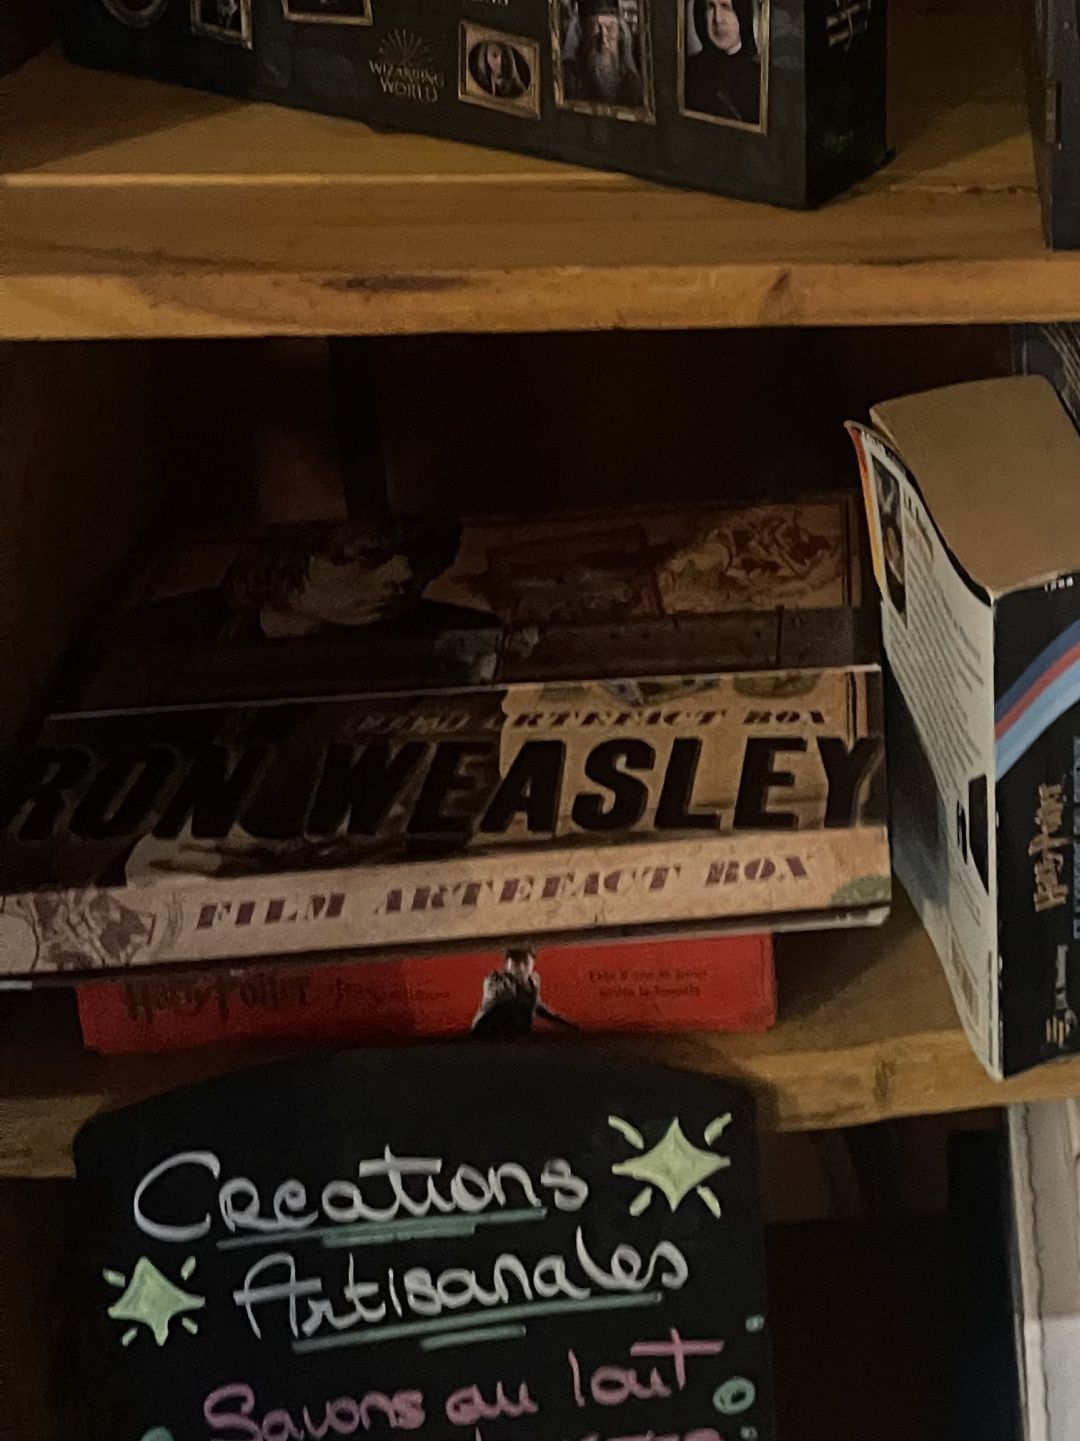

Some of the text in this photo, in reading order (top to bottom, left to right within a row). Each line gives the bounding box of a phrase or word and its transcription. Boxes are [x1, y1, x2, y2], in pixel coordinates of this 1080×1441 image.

[305, 735, 882, 840] WEASLEY
[196, 855, 815, 930] FILM ARTEFACT BOX
[134, 1144, 589, 1242] Creations
[233, 1226, 688, 1338] Artisanales
[203, 1382, 426, 1441] Savons
[445, 1381, 539, 1422] au
